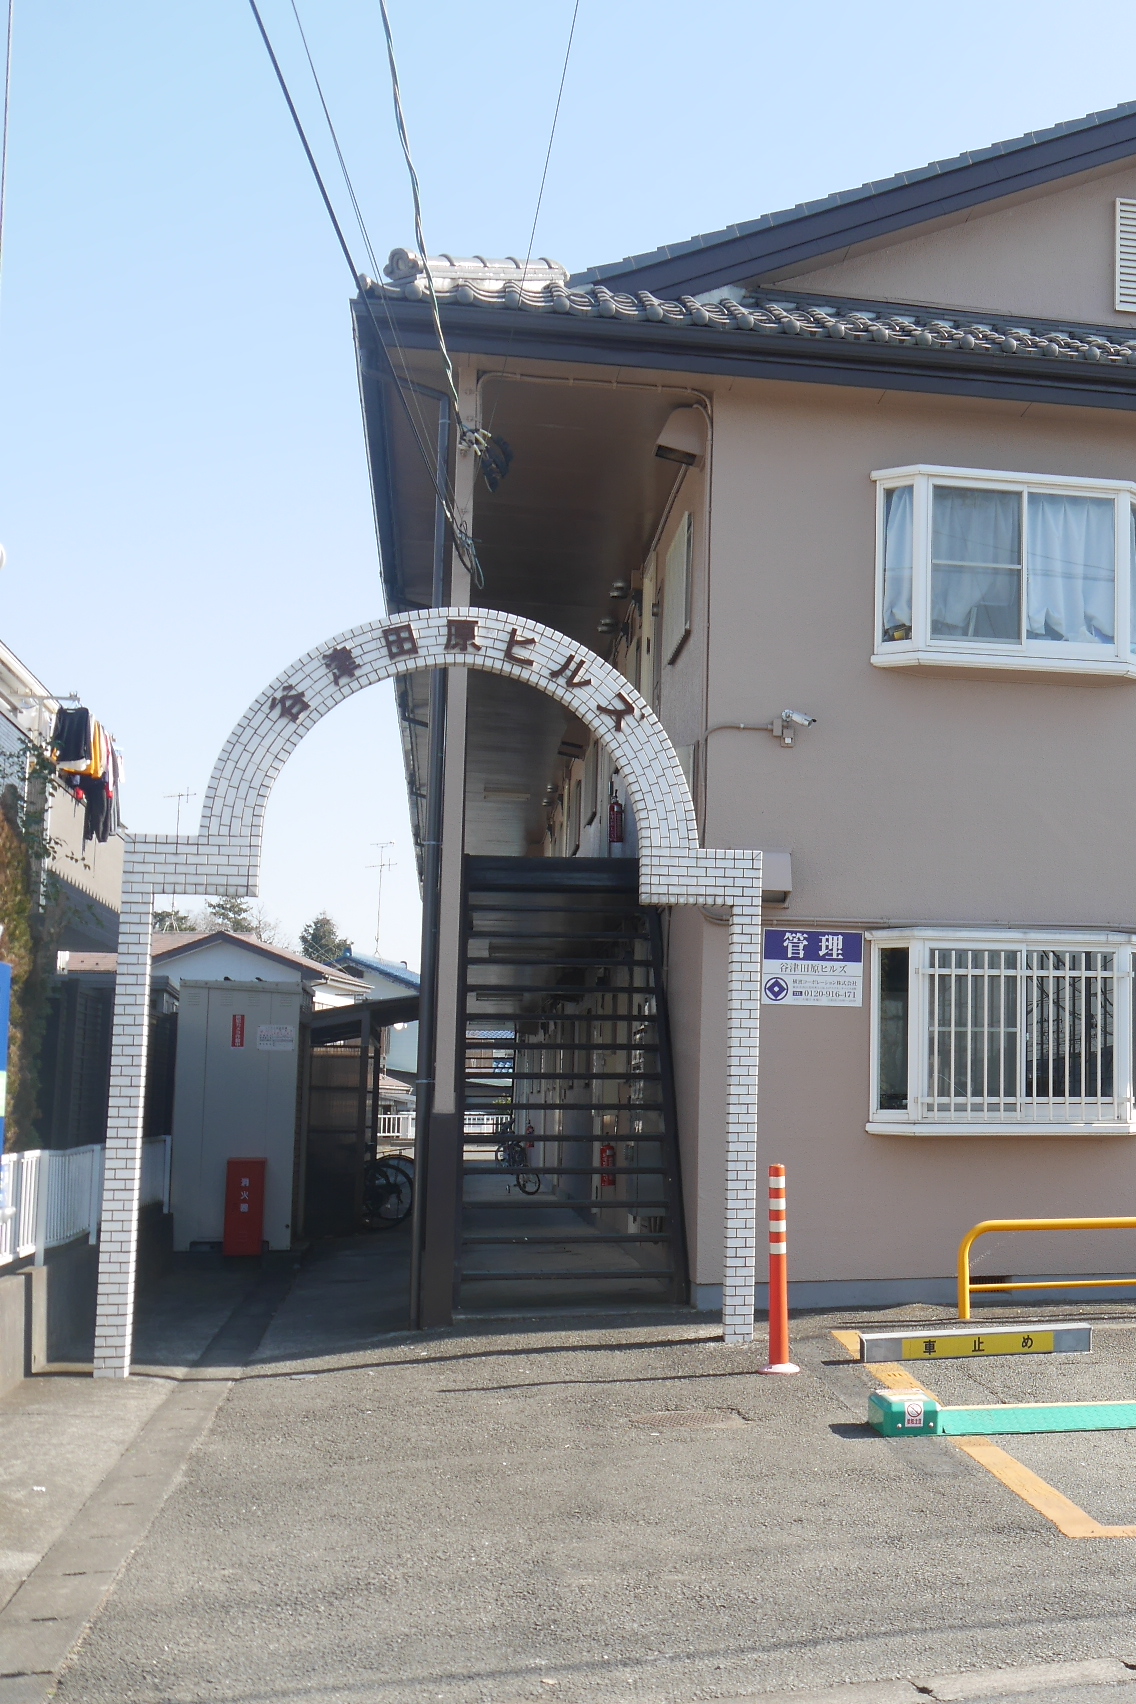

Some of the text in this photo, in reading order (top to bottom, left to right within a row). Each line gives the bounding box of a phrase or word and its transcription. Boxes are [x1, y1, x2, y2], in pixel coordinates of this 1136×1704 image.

[783, 932, 844, 959] 管理
[780, 962, 848, 974] 谷津田原ヒルズ
[923, 1334, 1034, 1356] 車止め
